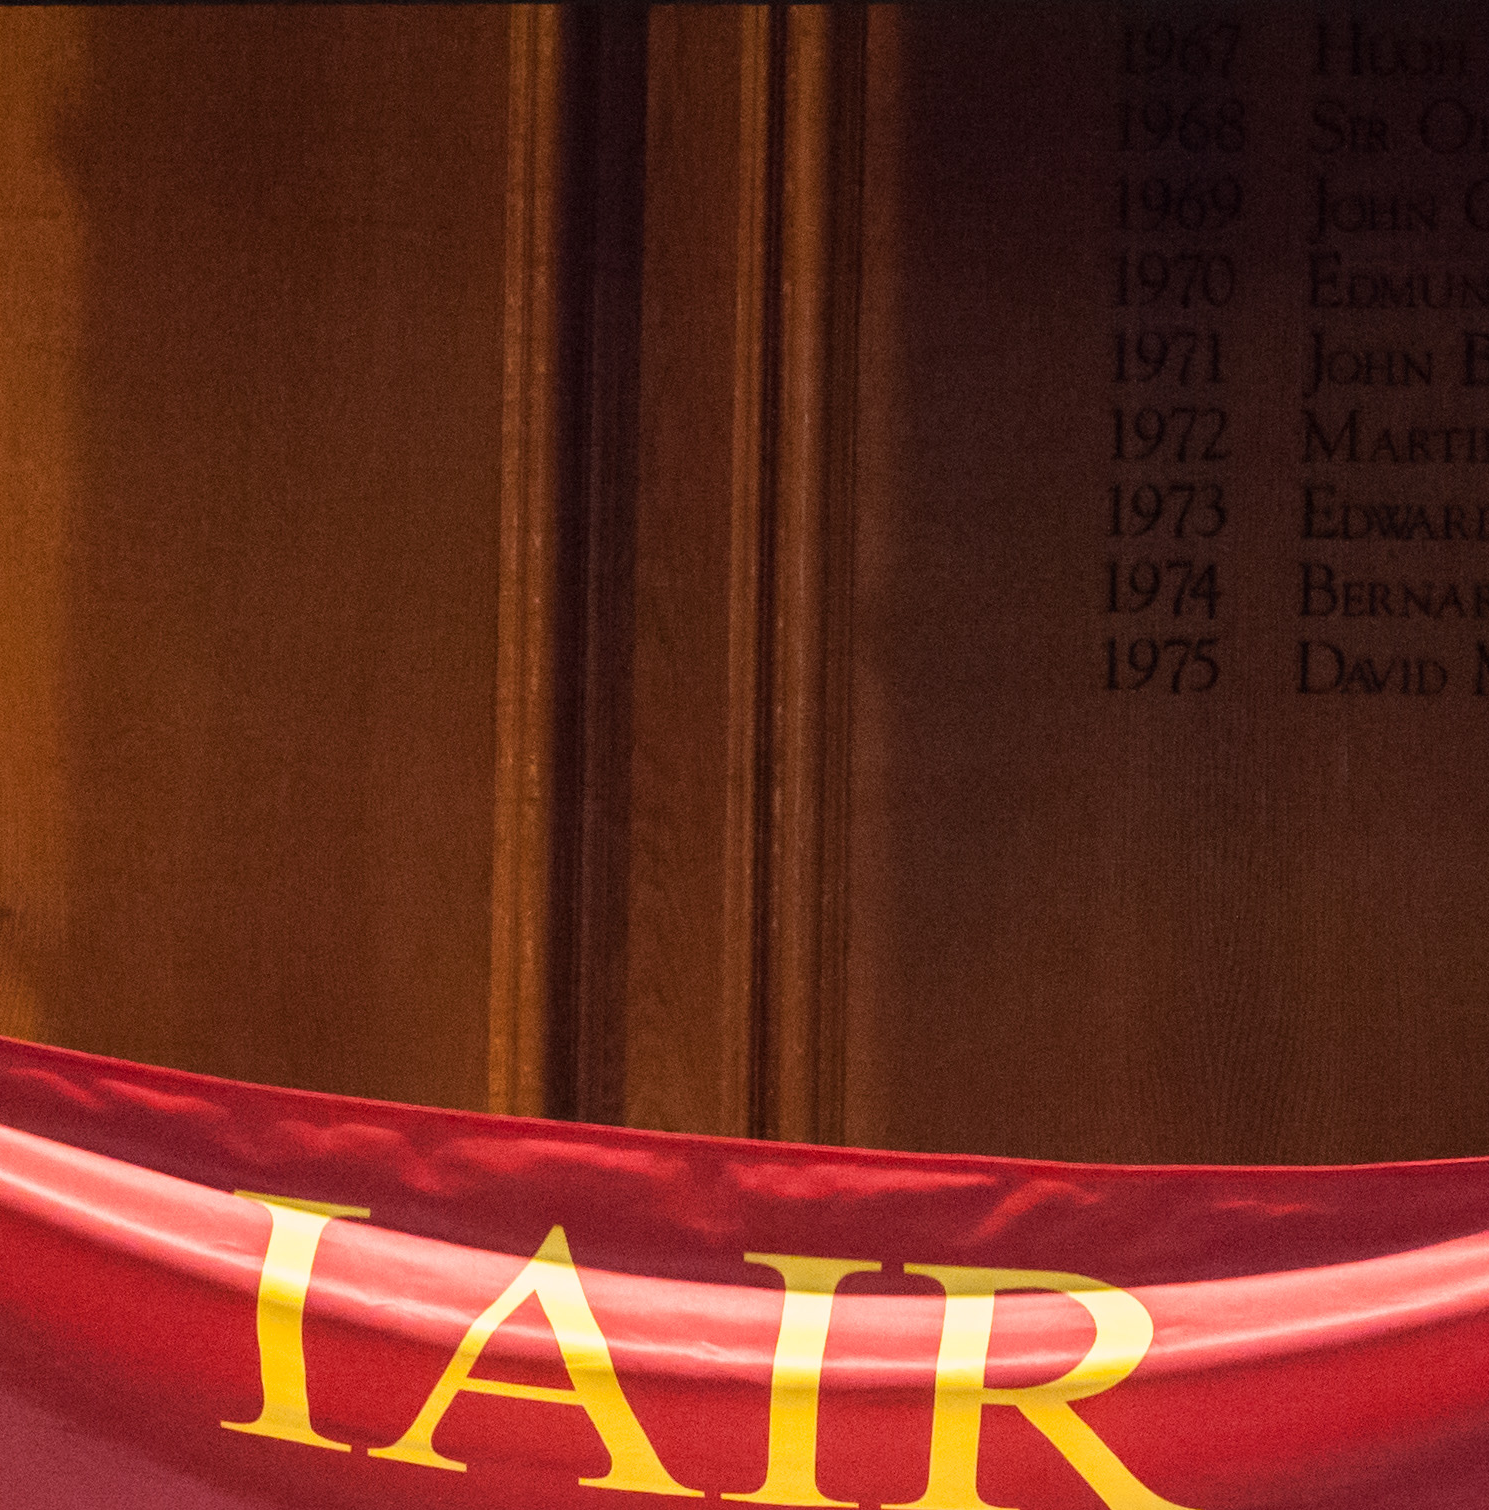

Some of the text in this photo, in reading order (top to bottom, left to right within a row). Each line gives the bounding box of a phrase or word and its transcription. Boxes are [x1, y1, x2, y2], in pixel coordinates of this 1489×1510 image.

[1113, 97, 1247, 154] 1968
[1112, 174, 1244, 232] 1969
[1109, 251, 1238, 309] 1970
[1109, 329, 1226, 387] 1971
[1108, 405, 1234, 464] 1972
[1106, 482, 1229, 540] 1973
[1101, 559, 1223, 620] 1974
[1100, 637, 1222, 695] 1975
